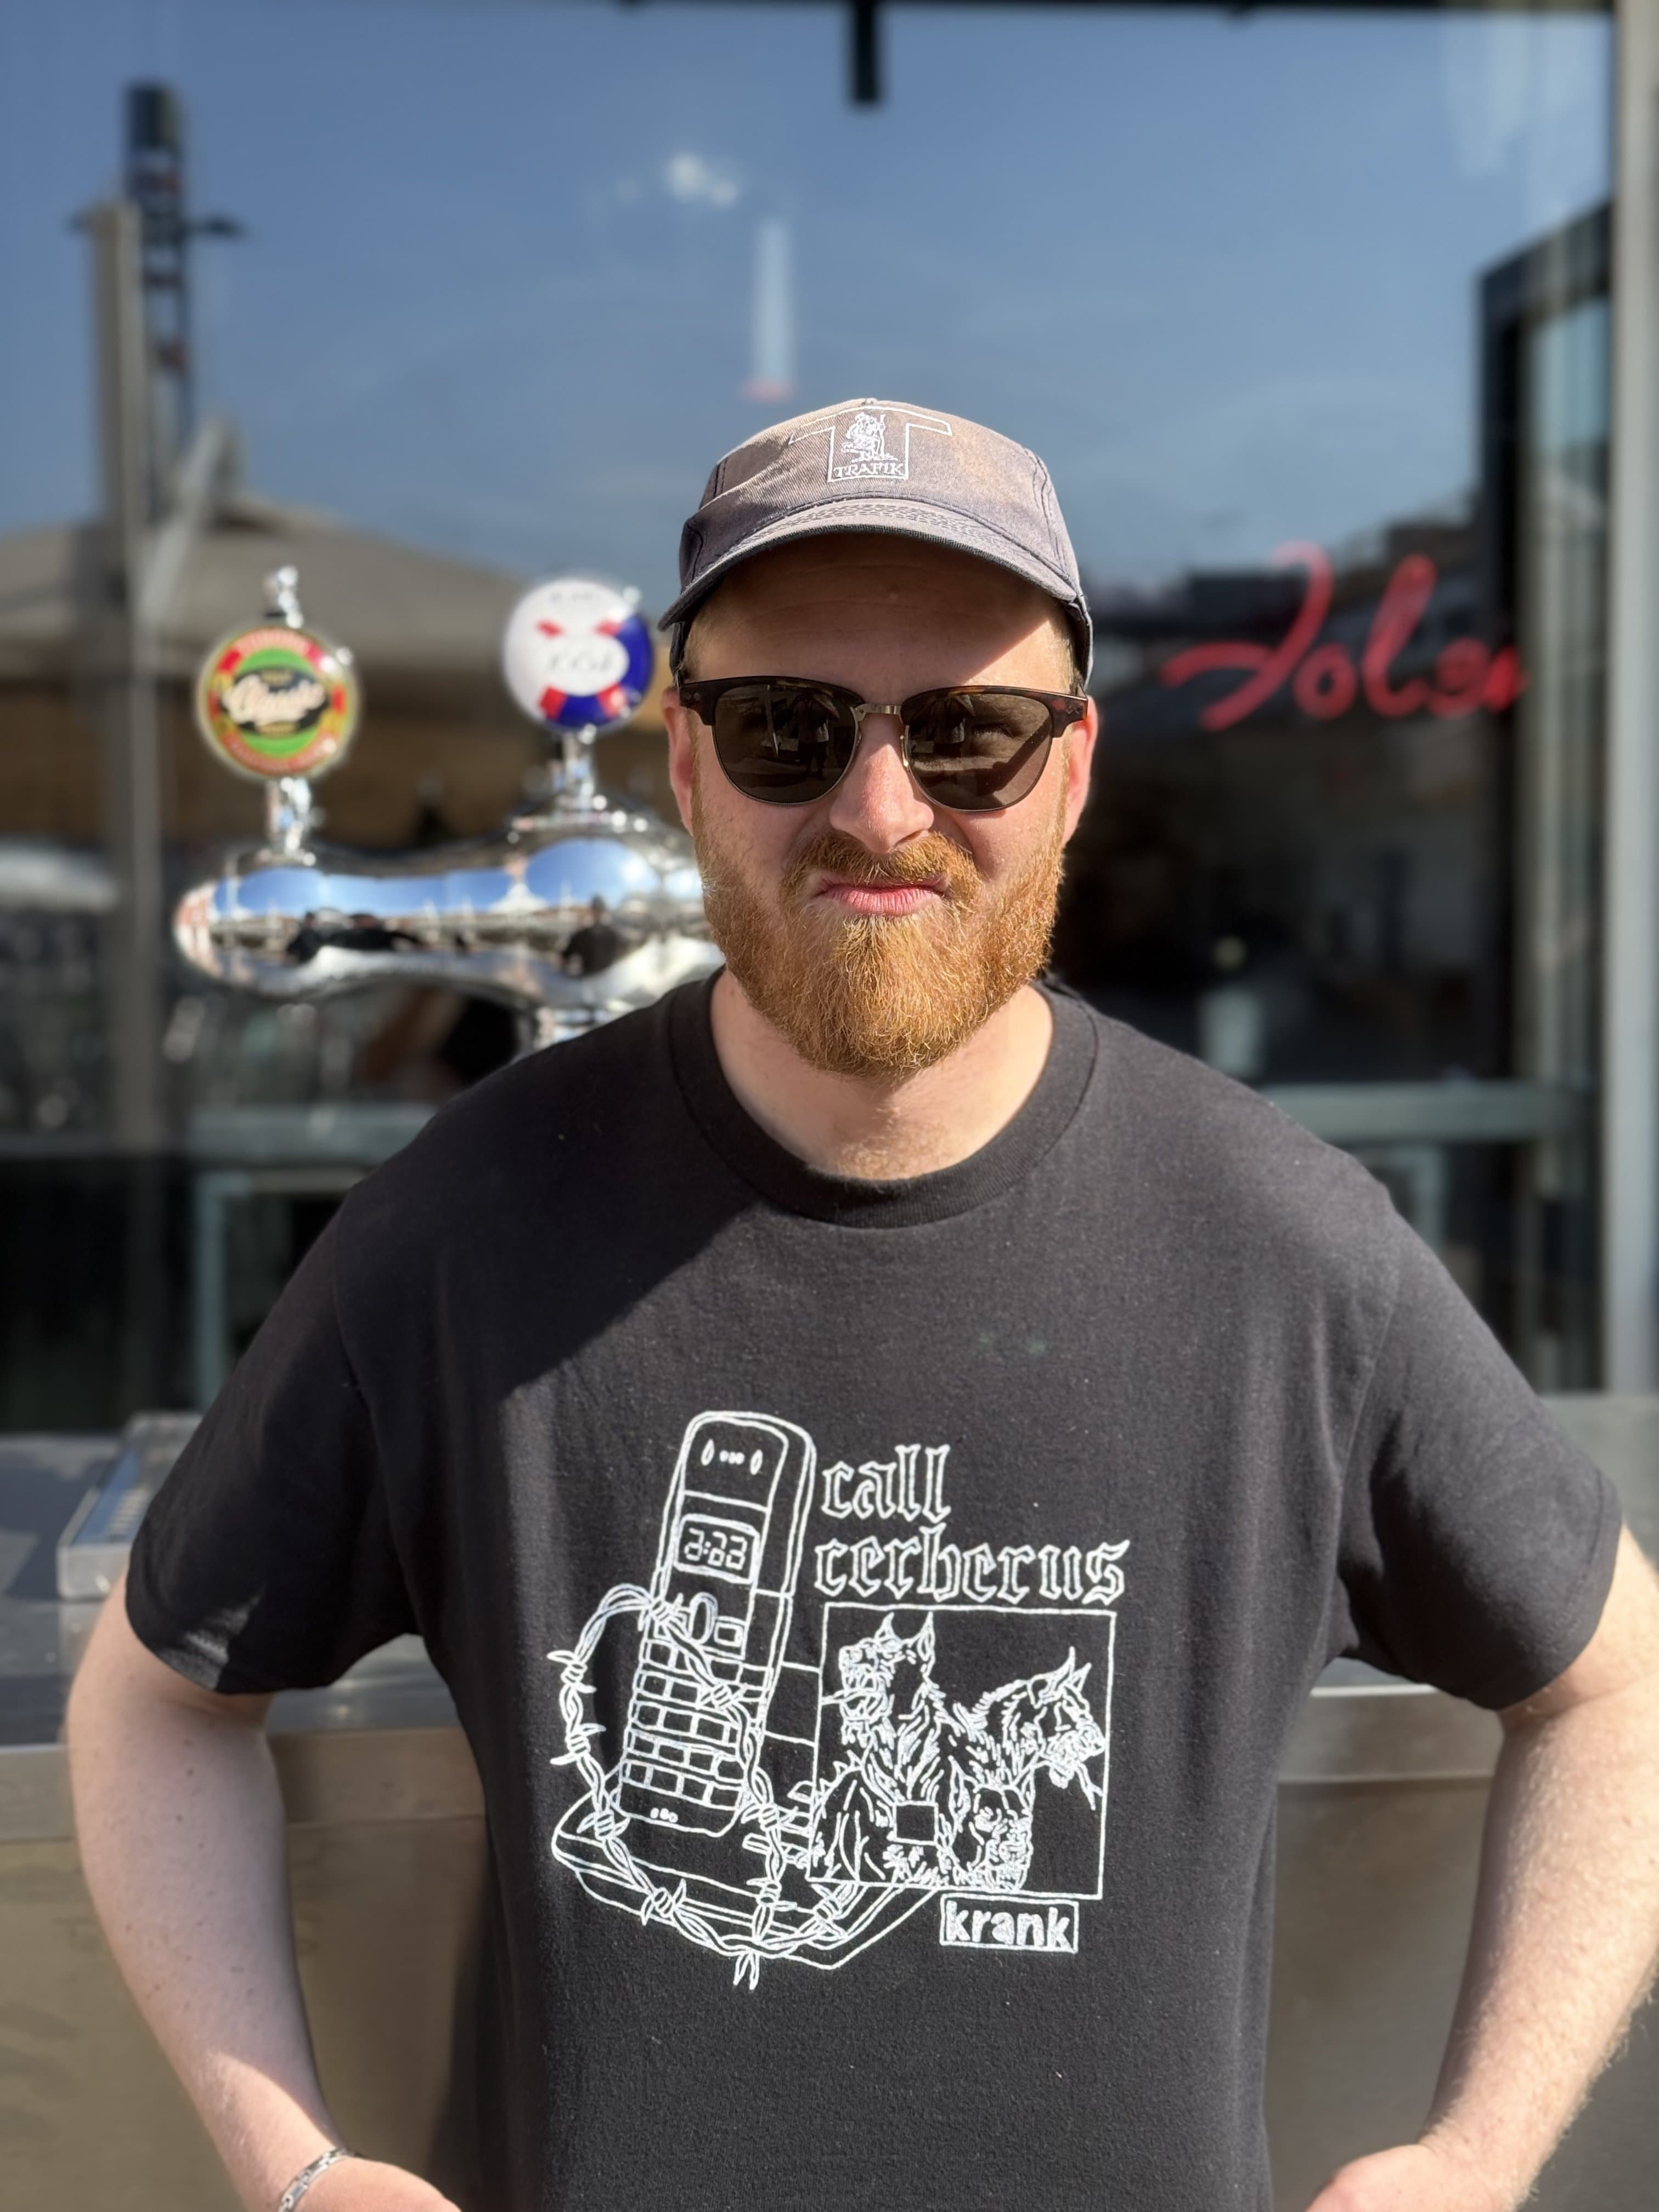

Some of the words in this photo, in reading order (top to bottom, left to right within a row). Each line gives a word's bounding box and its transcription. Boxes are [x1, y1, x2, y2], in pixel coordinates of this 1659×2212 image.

[821, 1443, 951, 1523] call
[814, 1522, 1130, 1605] cerberus
[945, 1900, 1072, 1948] krank
